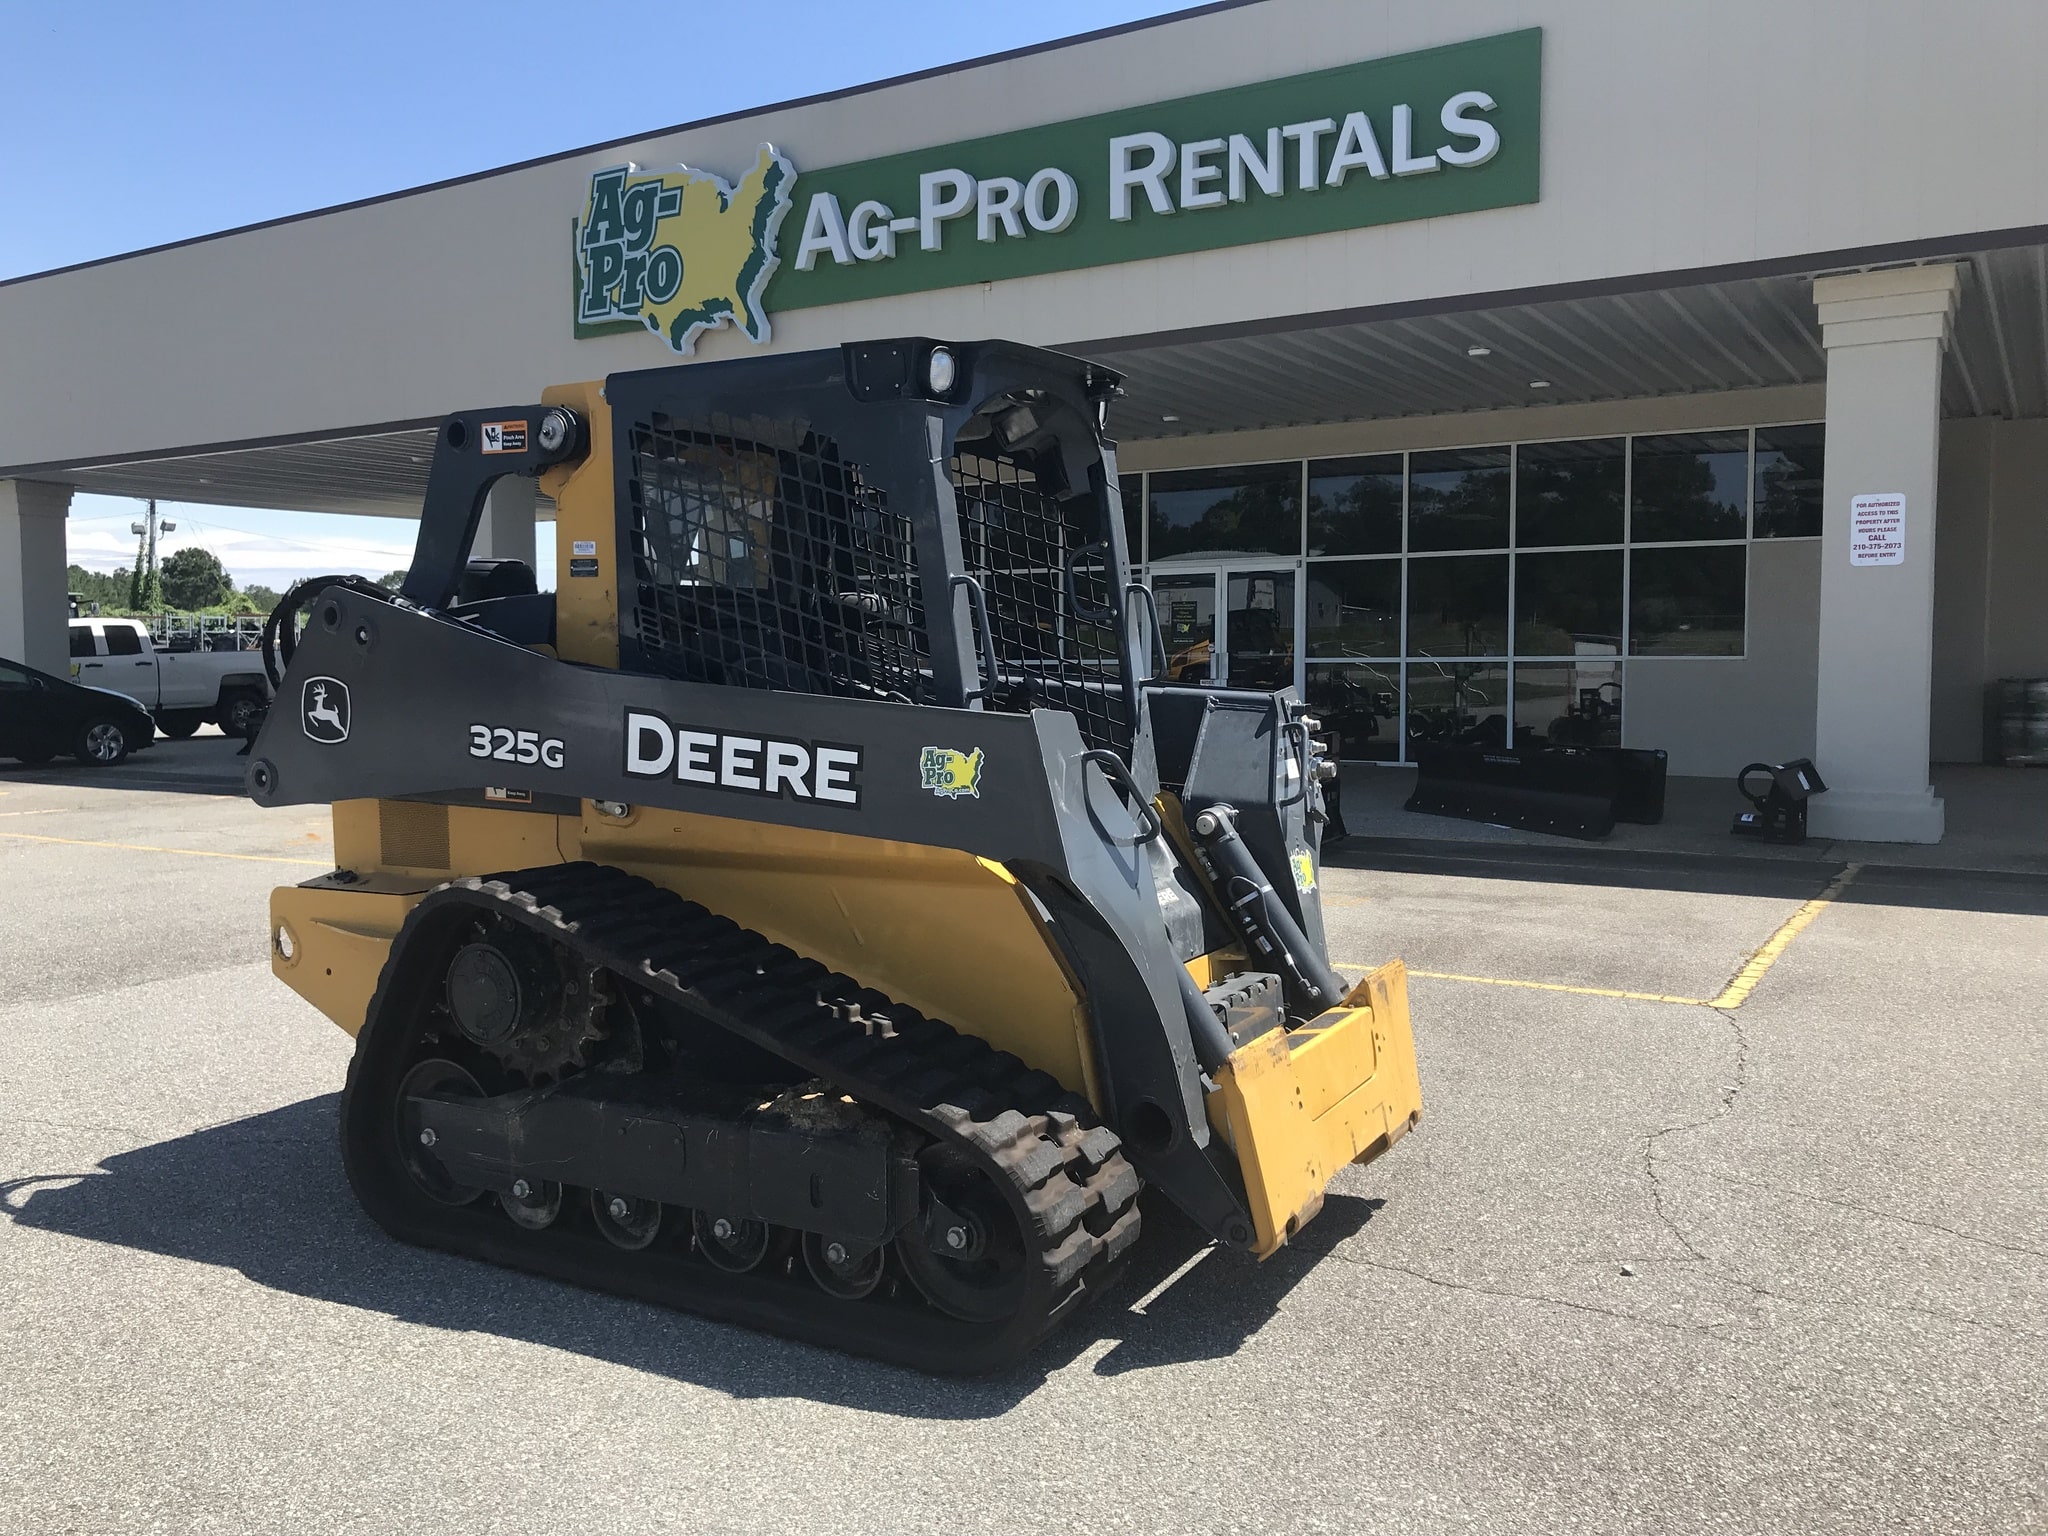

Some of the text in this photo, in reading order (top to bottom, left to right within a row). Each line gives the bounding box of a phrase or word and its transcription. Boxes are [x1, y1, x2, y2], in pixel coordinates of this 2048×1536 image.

[582, 167, 683, 251] Ag-
[582, 240, 683, 318] Pro
[1853, 542, 1902, 550] 210-375-2073
[469, 712, 859, 803] 325G DEERE
[924, 749, 953, 771] Ag-
[924, 767, 954, 785] Pro
